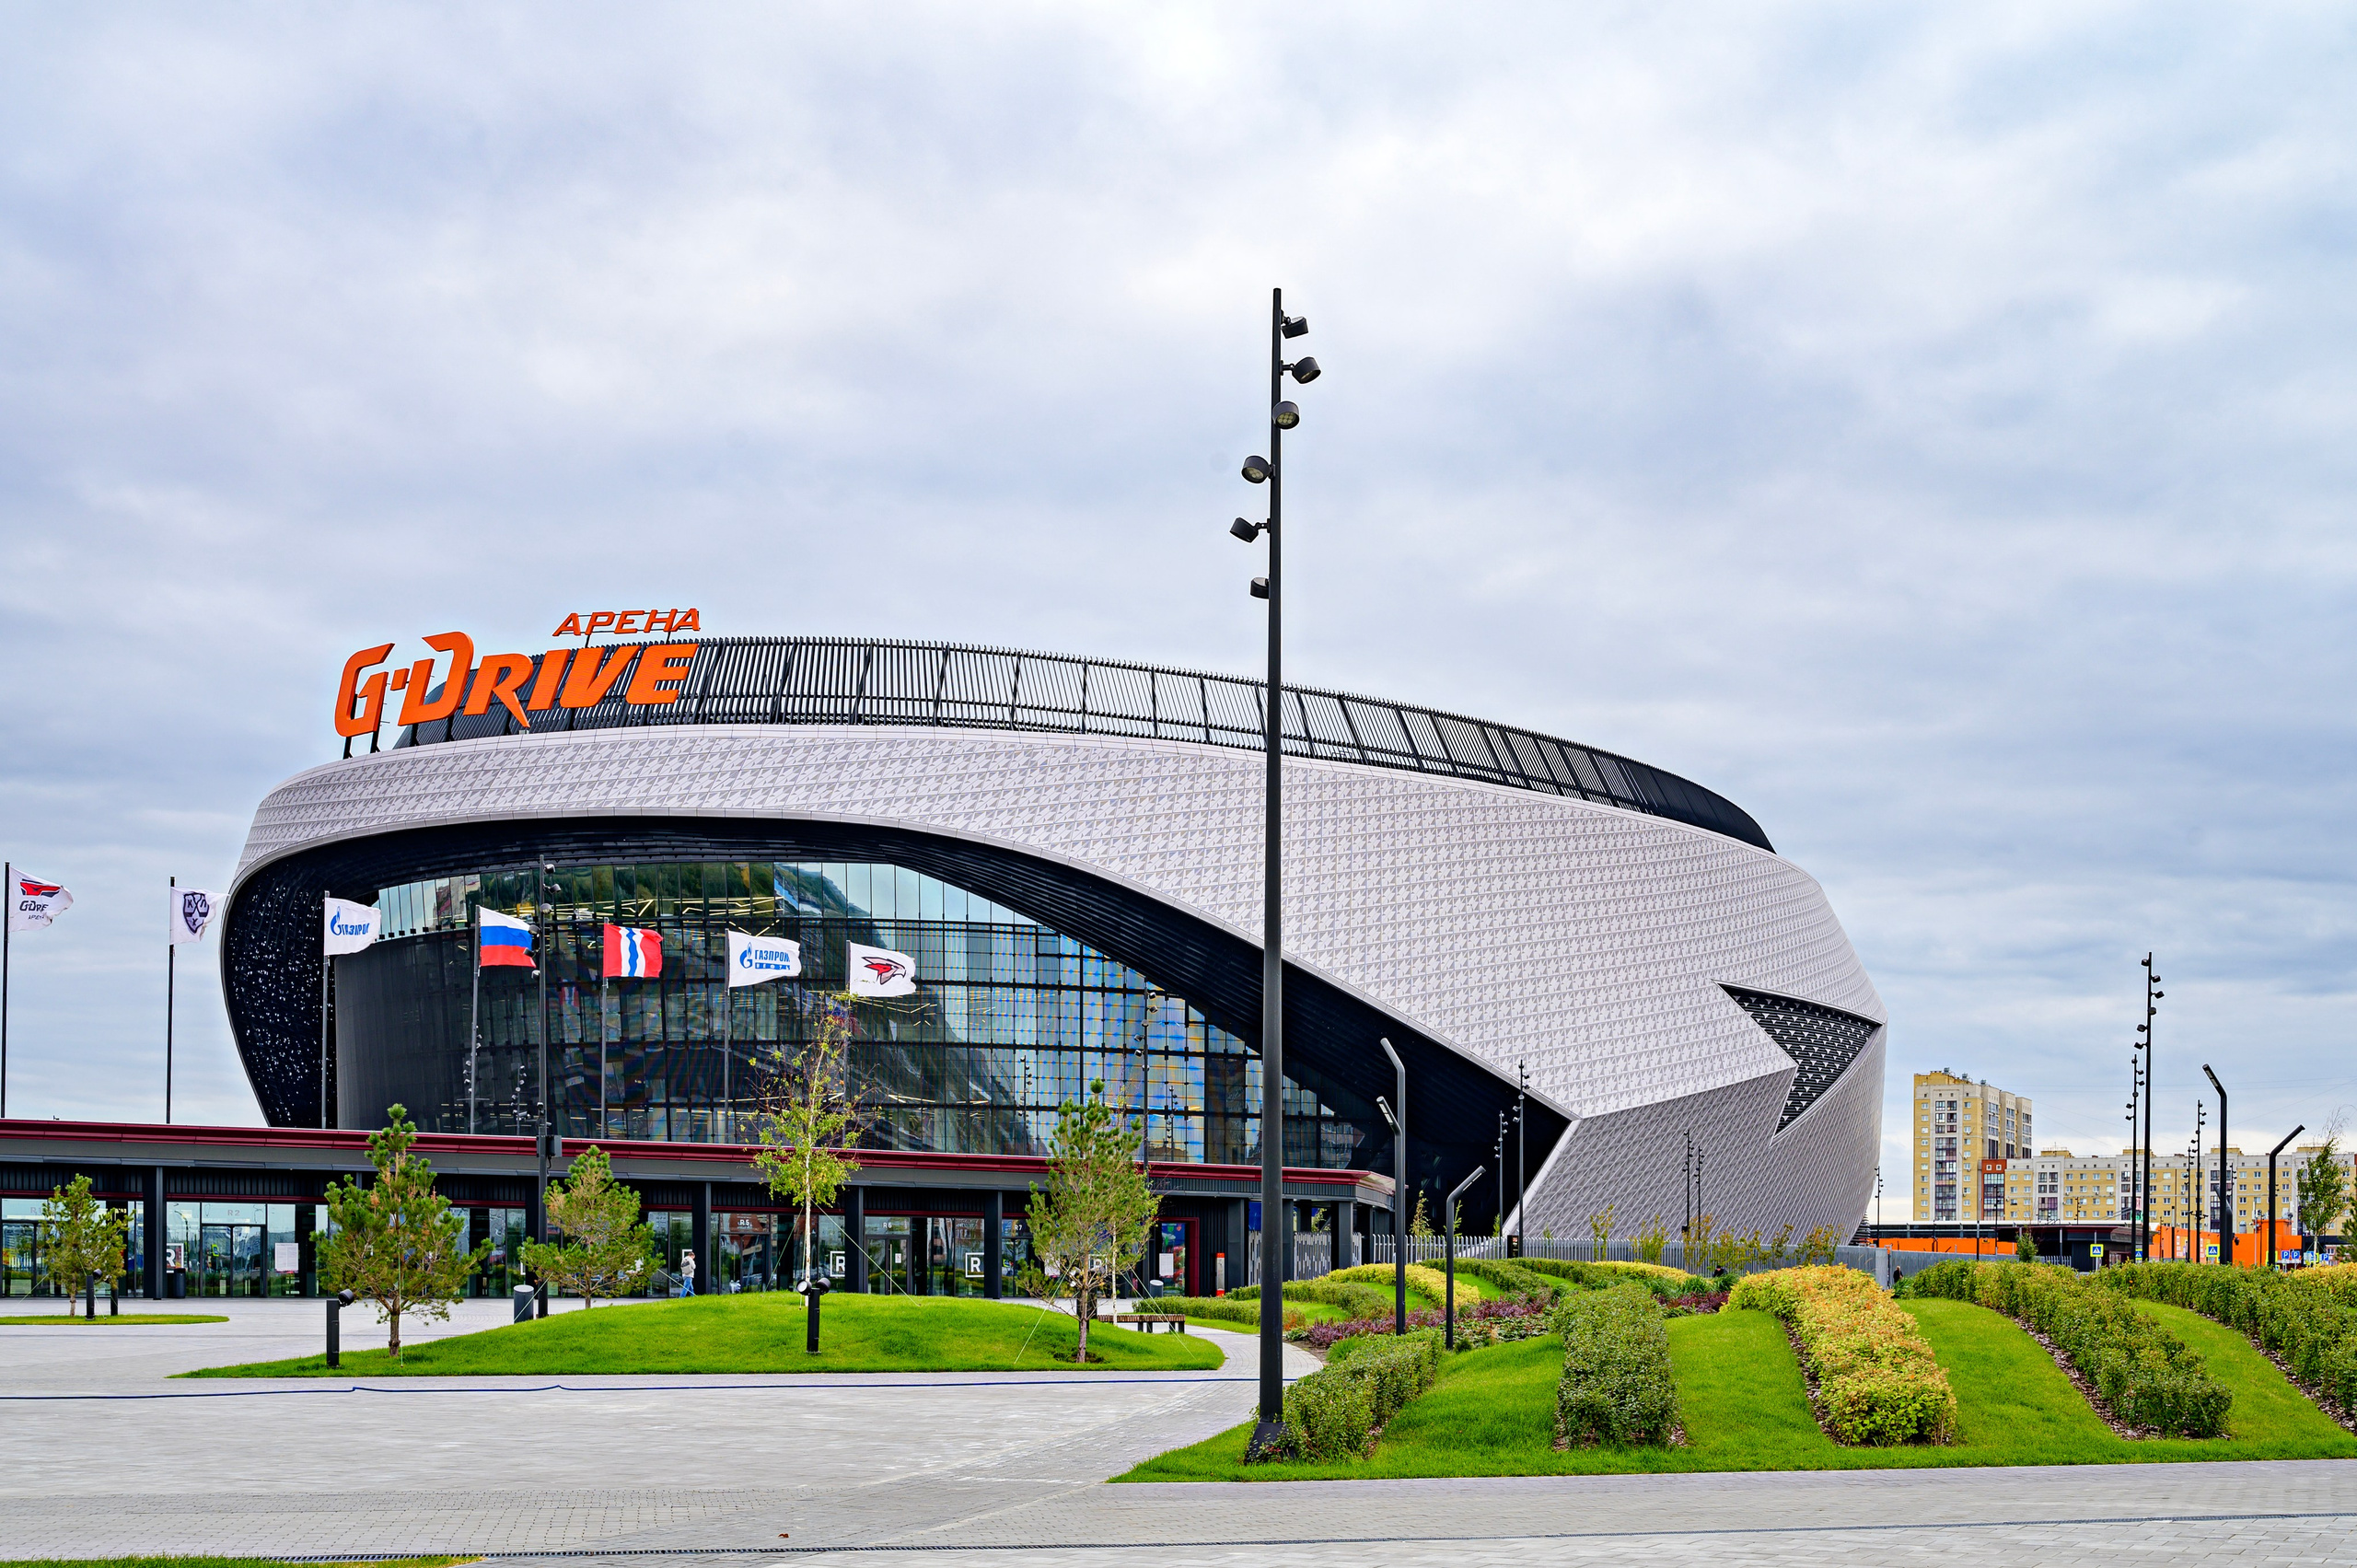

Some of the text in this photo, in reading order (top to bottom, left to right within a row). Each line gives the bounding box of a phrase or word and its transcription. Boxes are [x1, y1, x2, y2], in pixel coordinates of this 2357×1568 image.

[552, 608, 701, 637] АРЕНА
[166, 1249, 176, 1267] R
[836, 1256, 845, 1272] R
[970, 1257, 981, 1272] R
